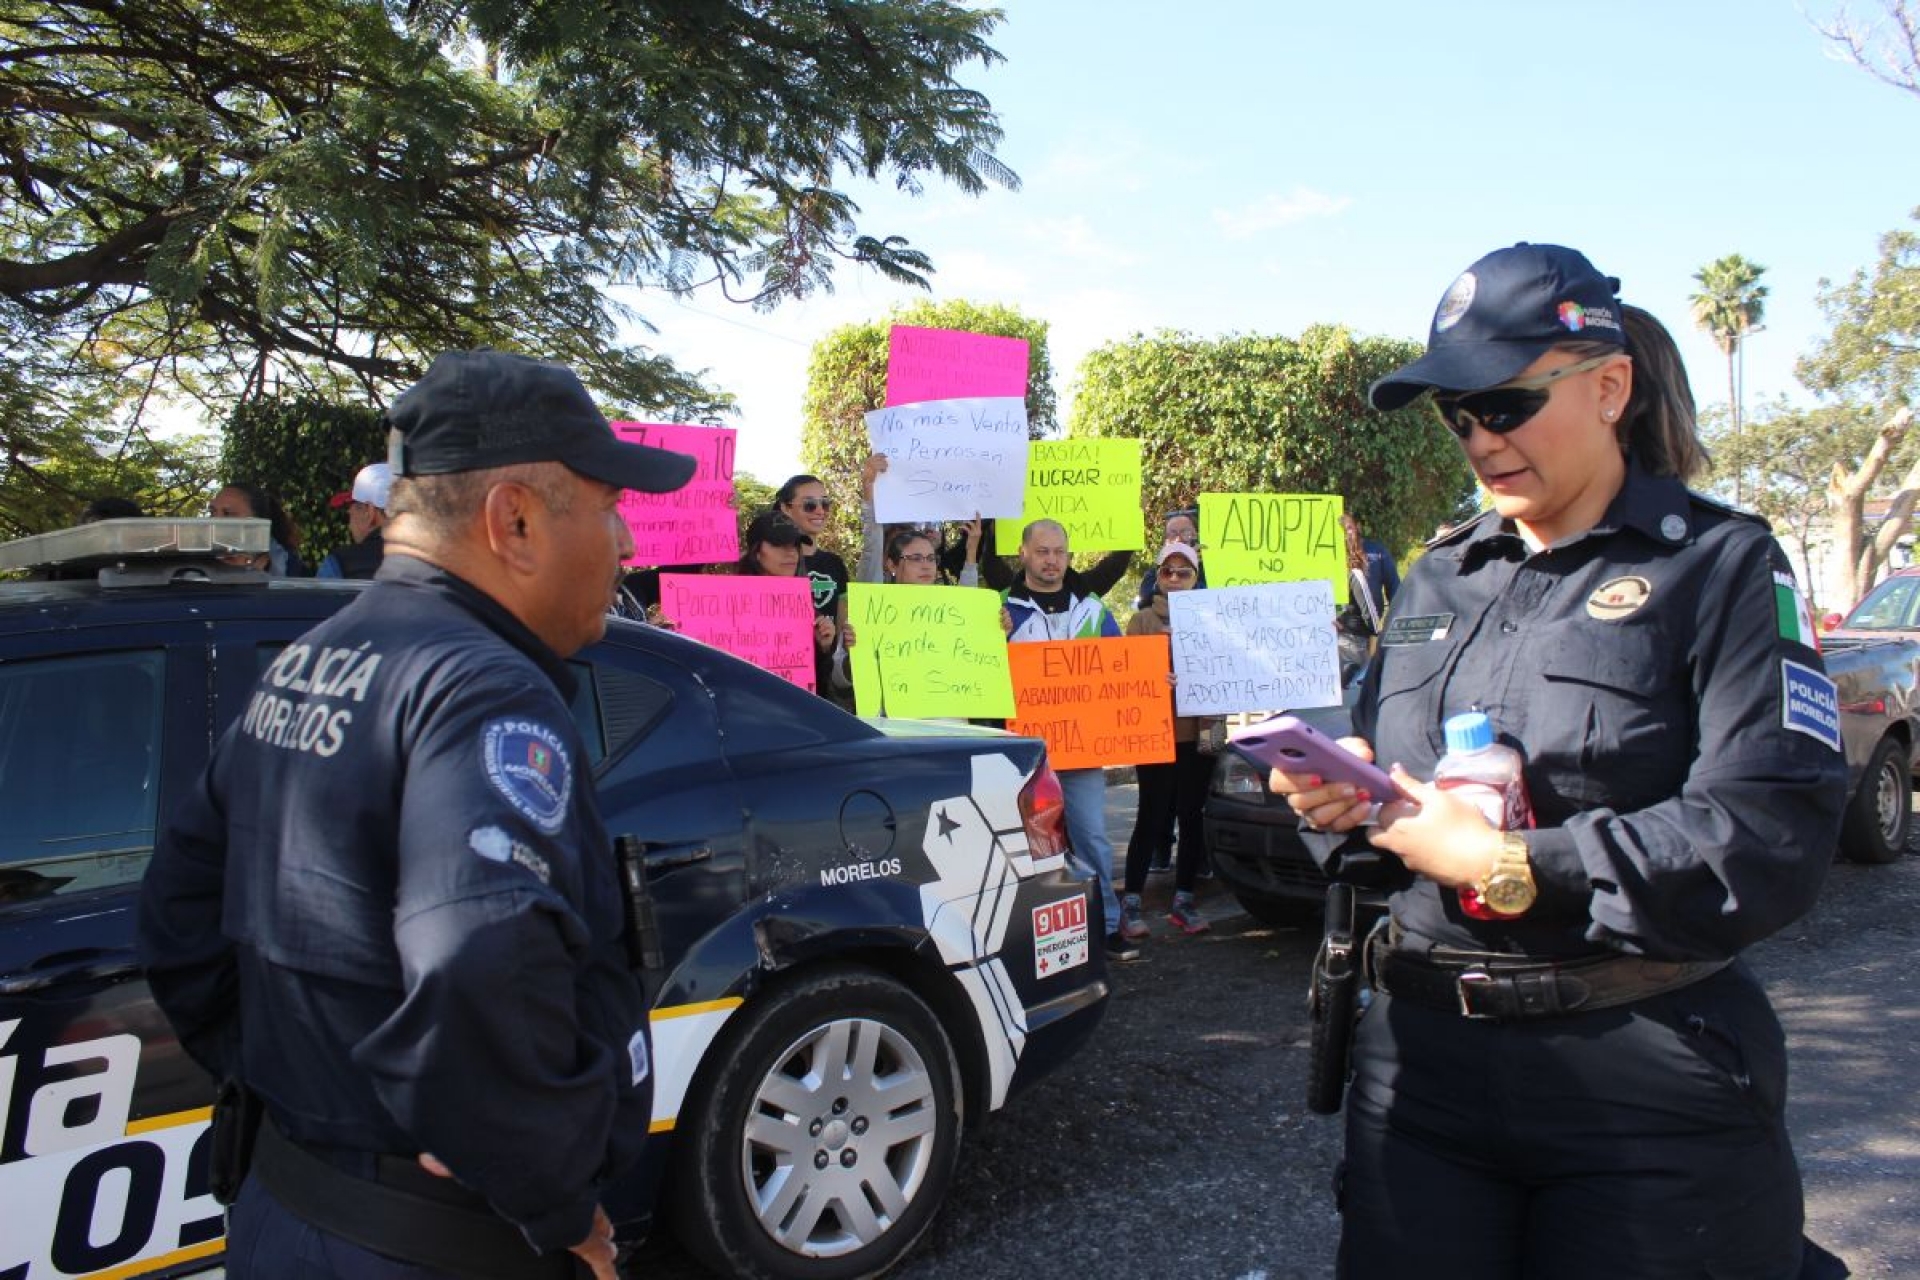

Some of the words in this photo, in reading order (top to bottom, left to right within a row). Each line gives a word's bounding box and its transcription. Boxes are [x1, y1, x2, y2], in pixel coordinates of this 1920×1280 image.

[881, 410, 903, 436] No
[970, 408, 1023, 436] Venta
[714, 436, 734, 481] 10
[908, 437, 976, 461] Perros
[1030, 468, 1101, 488] LUCRAR
[1108, 473, 1133, 486] con
[1036, 495, 1089, 515] VIDA
[1259, 558, 1285, 573] NO
[1042, 645, 1103, 678] EVITA
[1112, 648, 1129, 673] el
[1018, 684, 1091, 706] ABANDONO
[1098, 680, 1162, 700] ANIMAL
[1117, 706, 1142, 728] NO
[820, 858, 902, 887] MORELOS
[1037, 902, 1083, 933] 911
